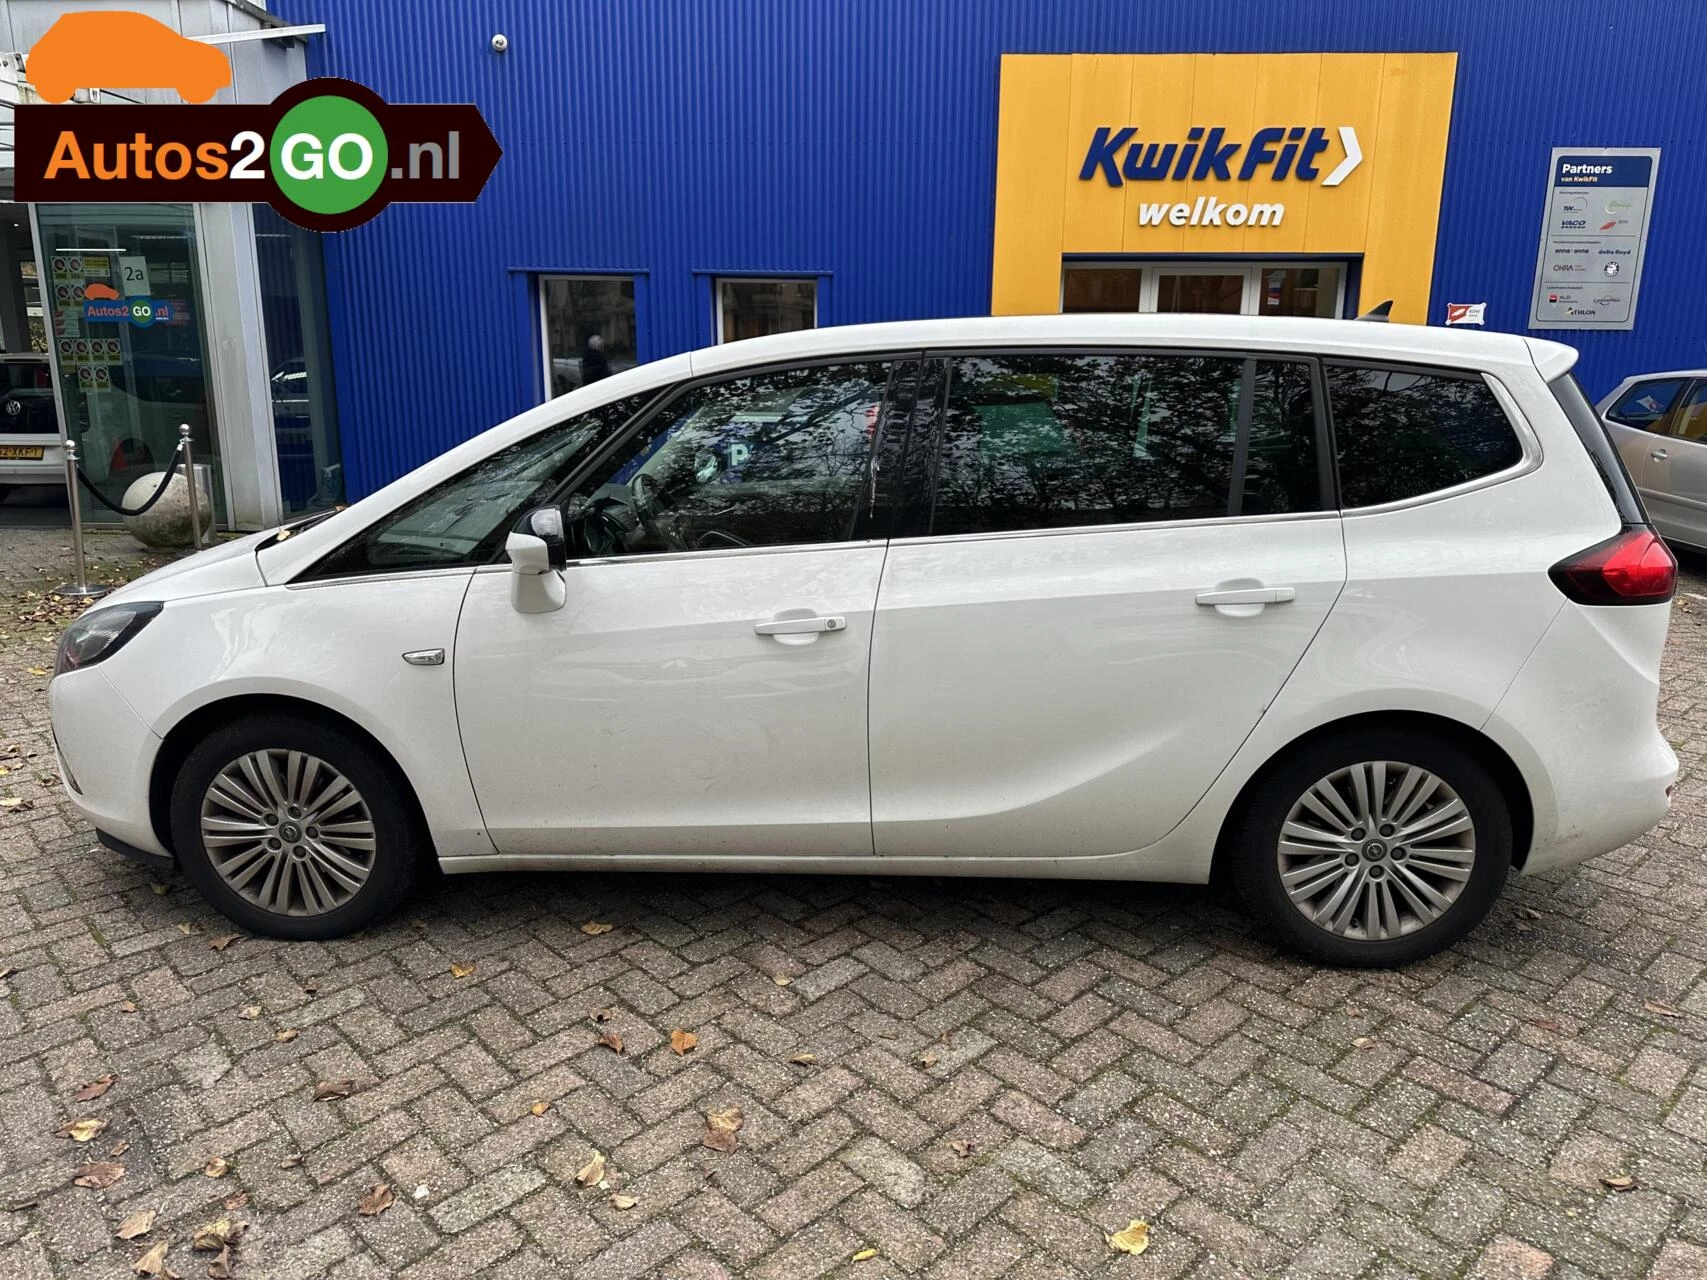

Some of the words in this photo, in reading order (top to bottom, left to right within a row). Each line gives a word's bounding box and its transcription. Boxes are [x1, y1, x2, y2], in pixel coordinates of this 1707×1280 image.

[1079, 127, 1330, 187] KwikFit
[1562, 163, 1612, 174] Partners
[1138, 196, 1284, 226] welkom
[125, 266, 144, 281] 2a
[731, 444, 749, 466] P
